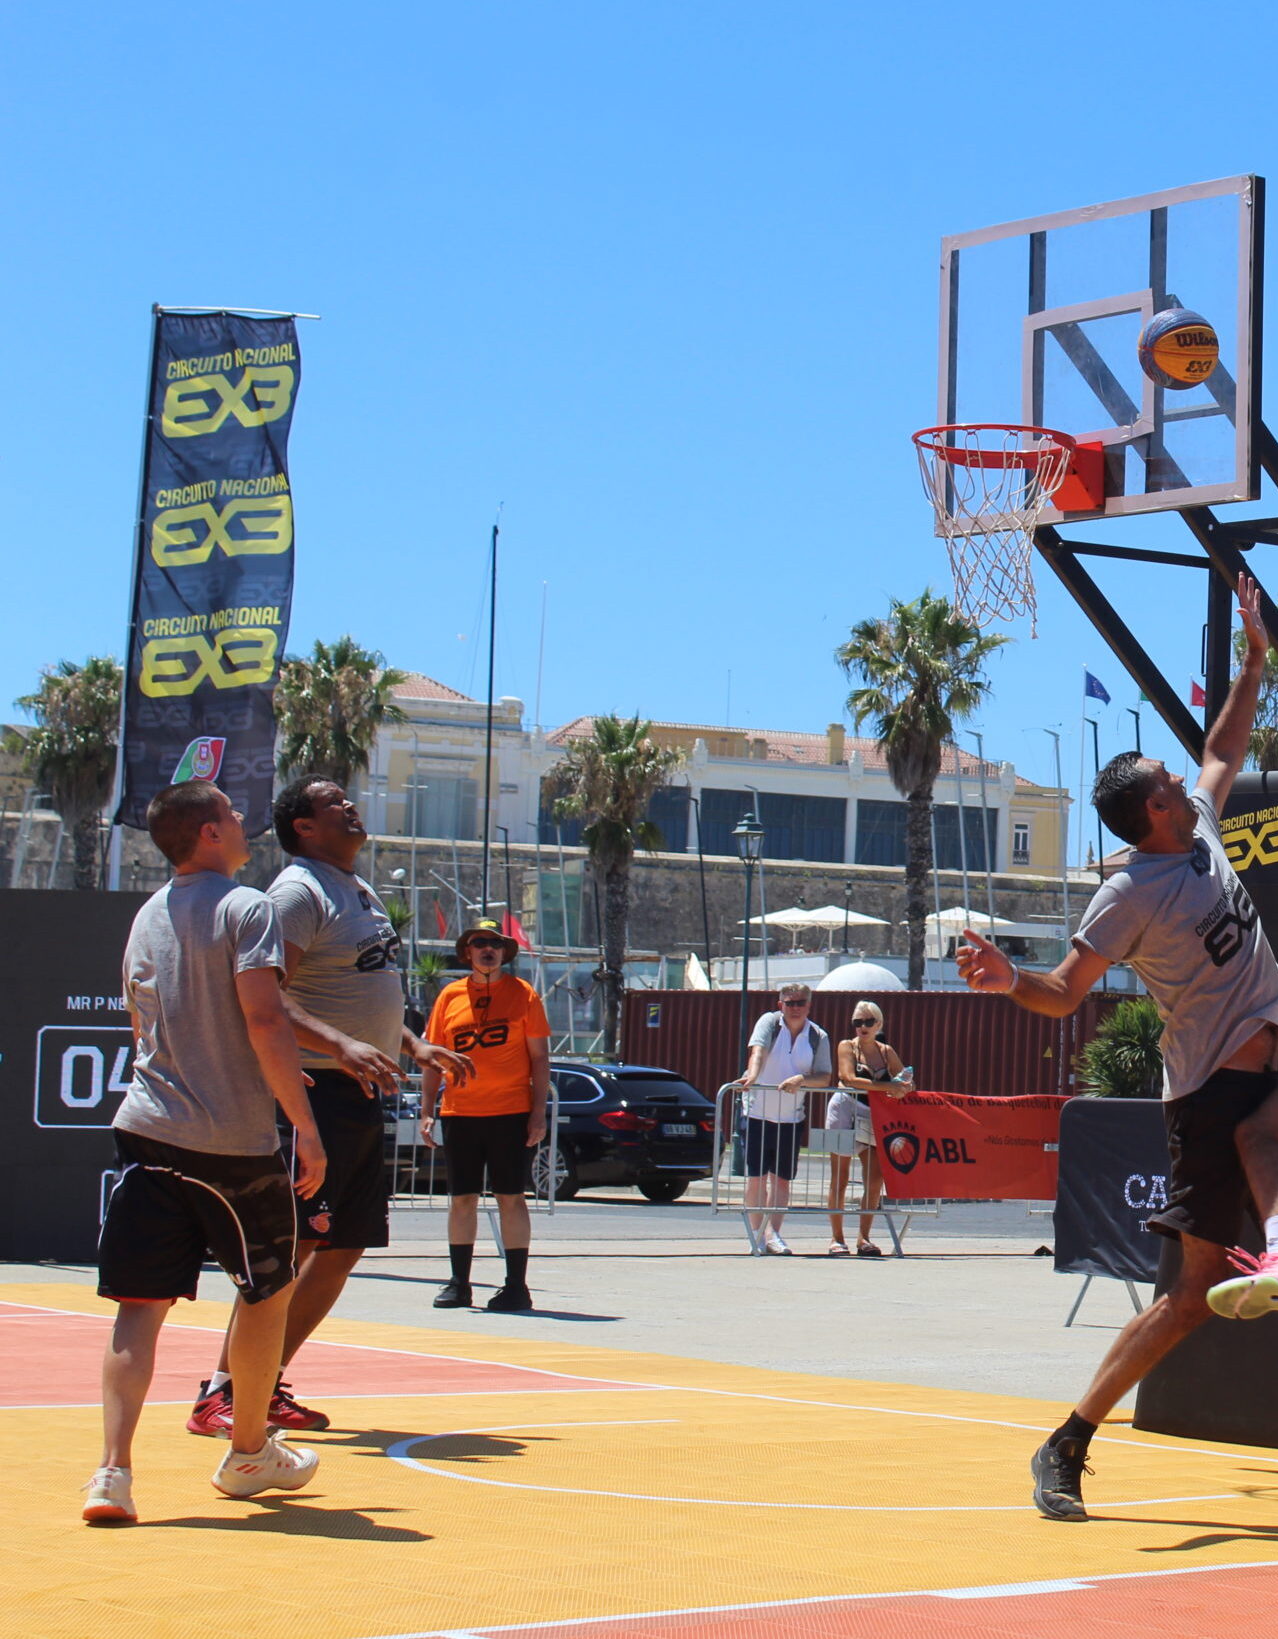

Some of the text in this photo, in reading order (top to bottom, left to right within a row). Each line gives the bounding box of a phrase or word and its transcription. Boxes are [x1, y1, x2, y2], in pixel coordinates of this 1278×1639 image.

[166, 352, 232, 379] CIRCUITO
[162, 365, 294, 438] EX3
[156, 479, 215, 508] CIRCUITO
[151, 494, 293, 567] EX3
[209, 606, 282, 630] NACIONAL
[139, 628, 278, 698] EX3
[67, 996, 91, 1010] MR
[94, 996, 105, 1010] P
[925, 1138, 976, 1164] ABL
